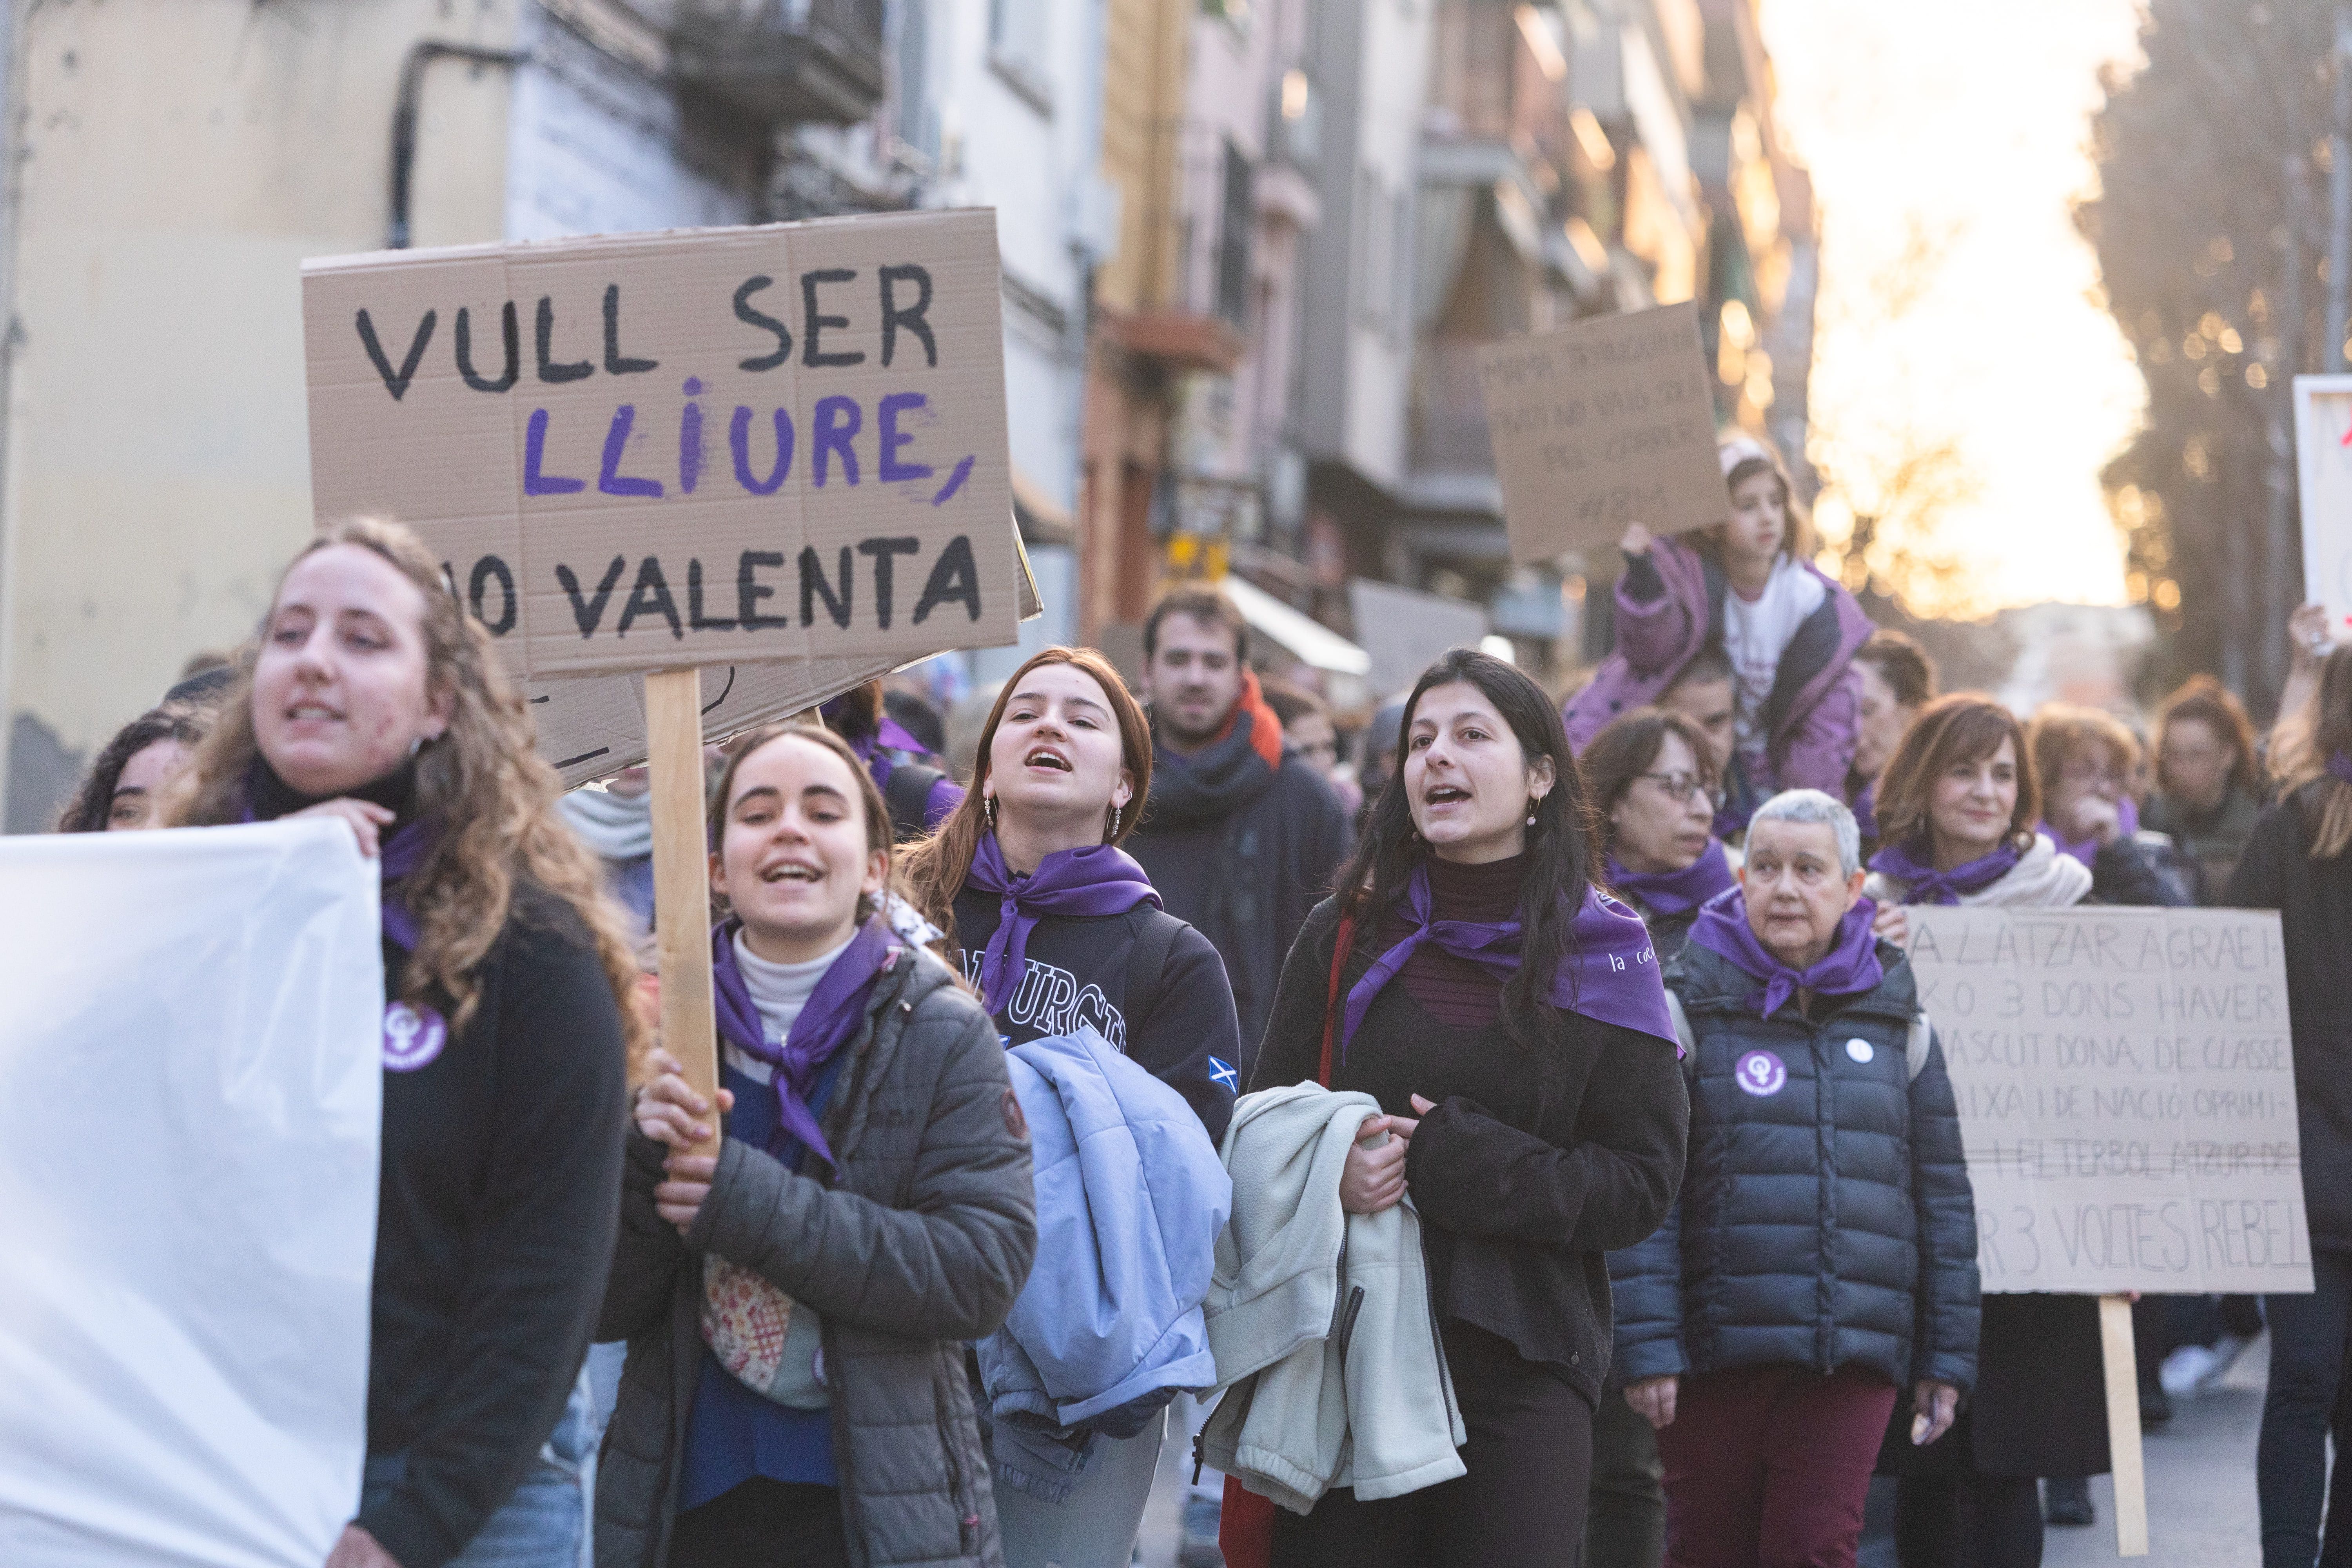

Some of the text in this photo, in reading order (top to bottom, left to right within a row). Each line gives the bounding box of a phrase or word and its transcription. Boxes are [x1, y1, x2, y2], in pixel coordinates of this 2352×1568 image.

[355, 263, 938, 402] VULL SER
[554, 534, 982, 641] VALENTA
[1608, 953, 1625, 972] la
[1909, 921, 1943, 964] A
[1997, 979, 2025, 1018] 3
[2041, 979, 2136, 1021] DONS
[2156, 983, 2278, 1022] HAVER
[2154, 1035, 2197, 1073] DE
[2203, 1036, 2289, 1073] CLASSE
[2013, 1205, 2042, 1277] 3
[2051, 1200, 2191, 1274] VOLTES
[2200, 1199, 2311, 1271] REBEL
